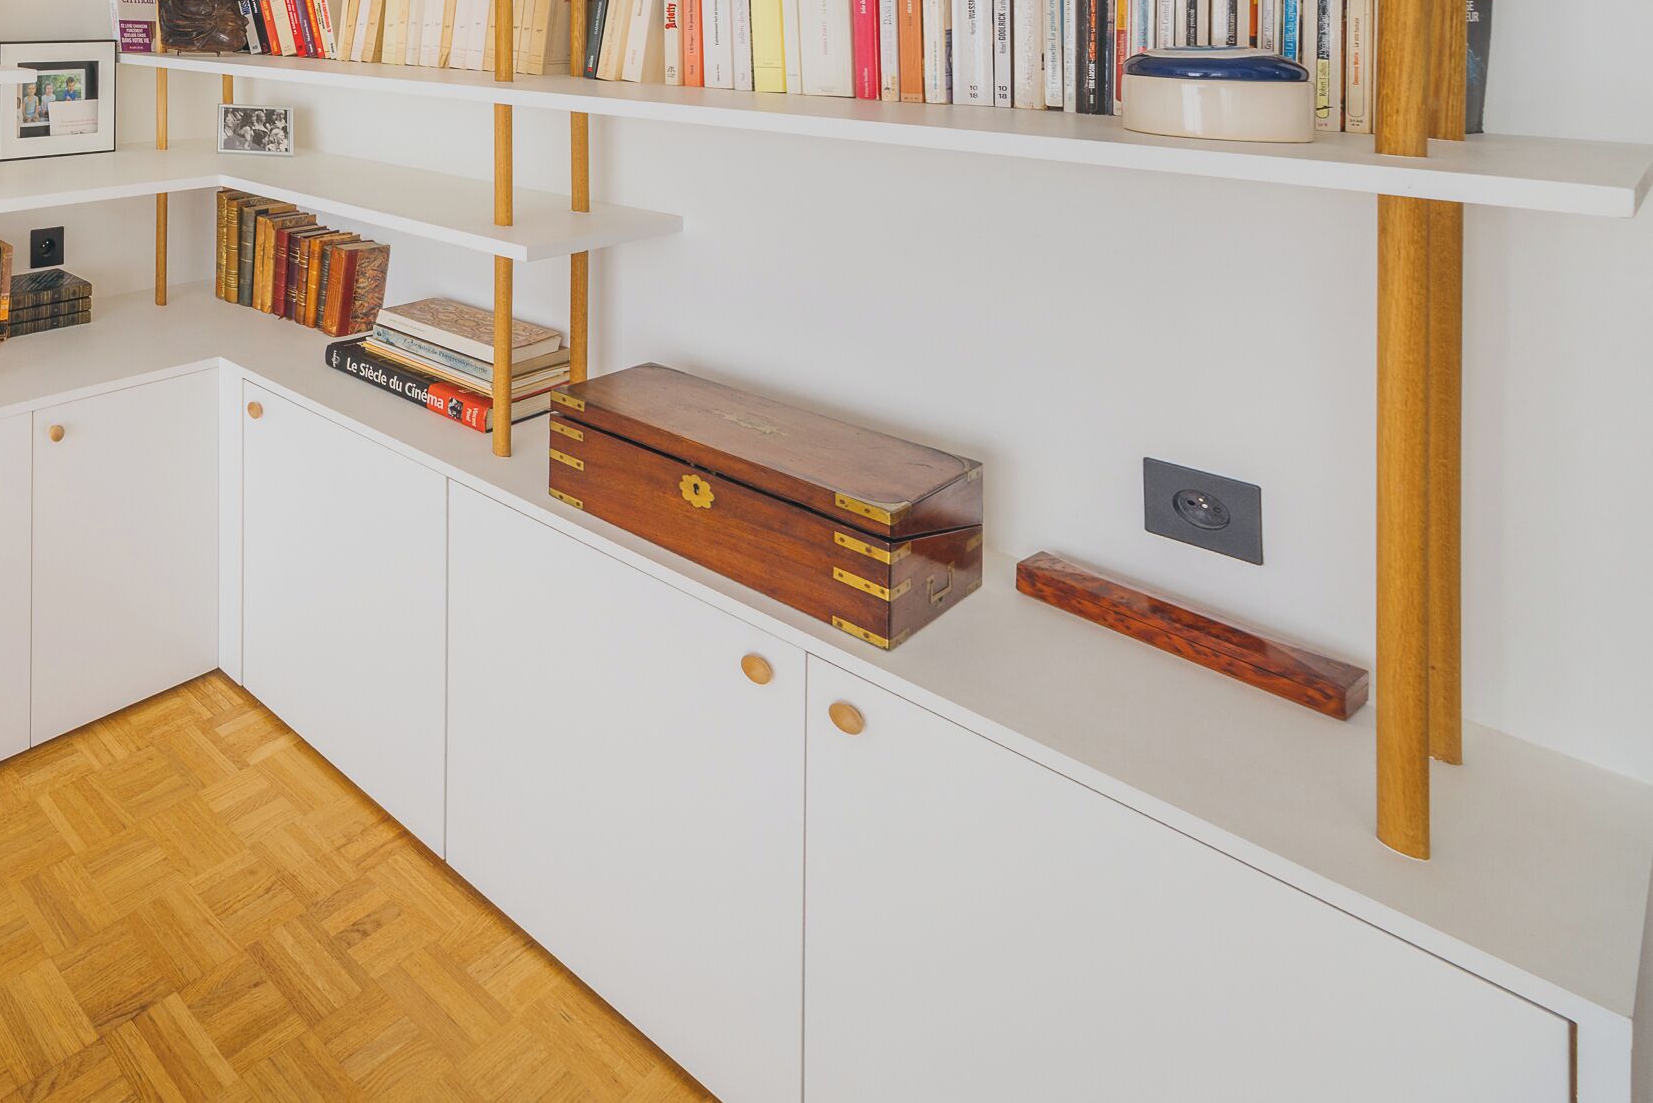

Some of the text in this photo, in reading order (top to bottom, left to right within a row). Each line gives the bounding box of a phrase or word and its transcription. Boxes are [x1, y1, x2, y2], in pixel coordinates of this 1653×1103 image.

[859, 4, 867, 14] Joie
[998, 12, 1007, 41] GOOLRICK
[346, 357, 444, 410] Le Siècle du Cinéma
